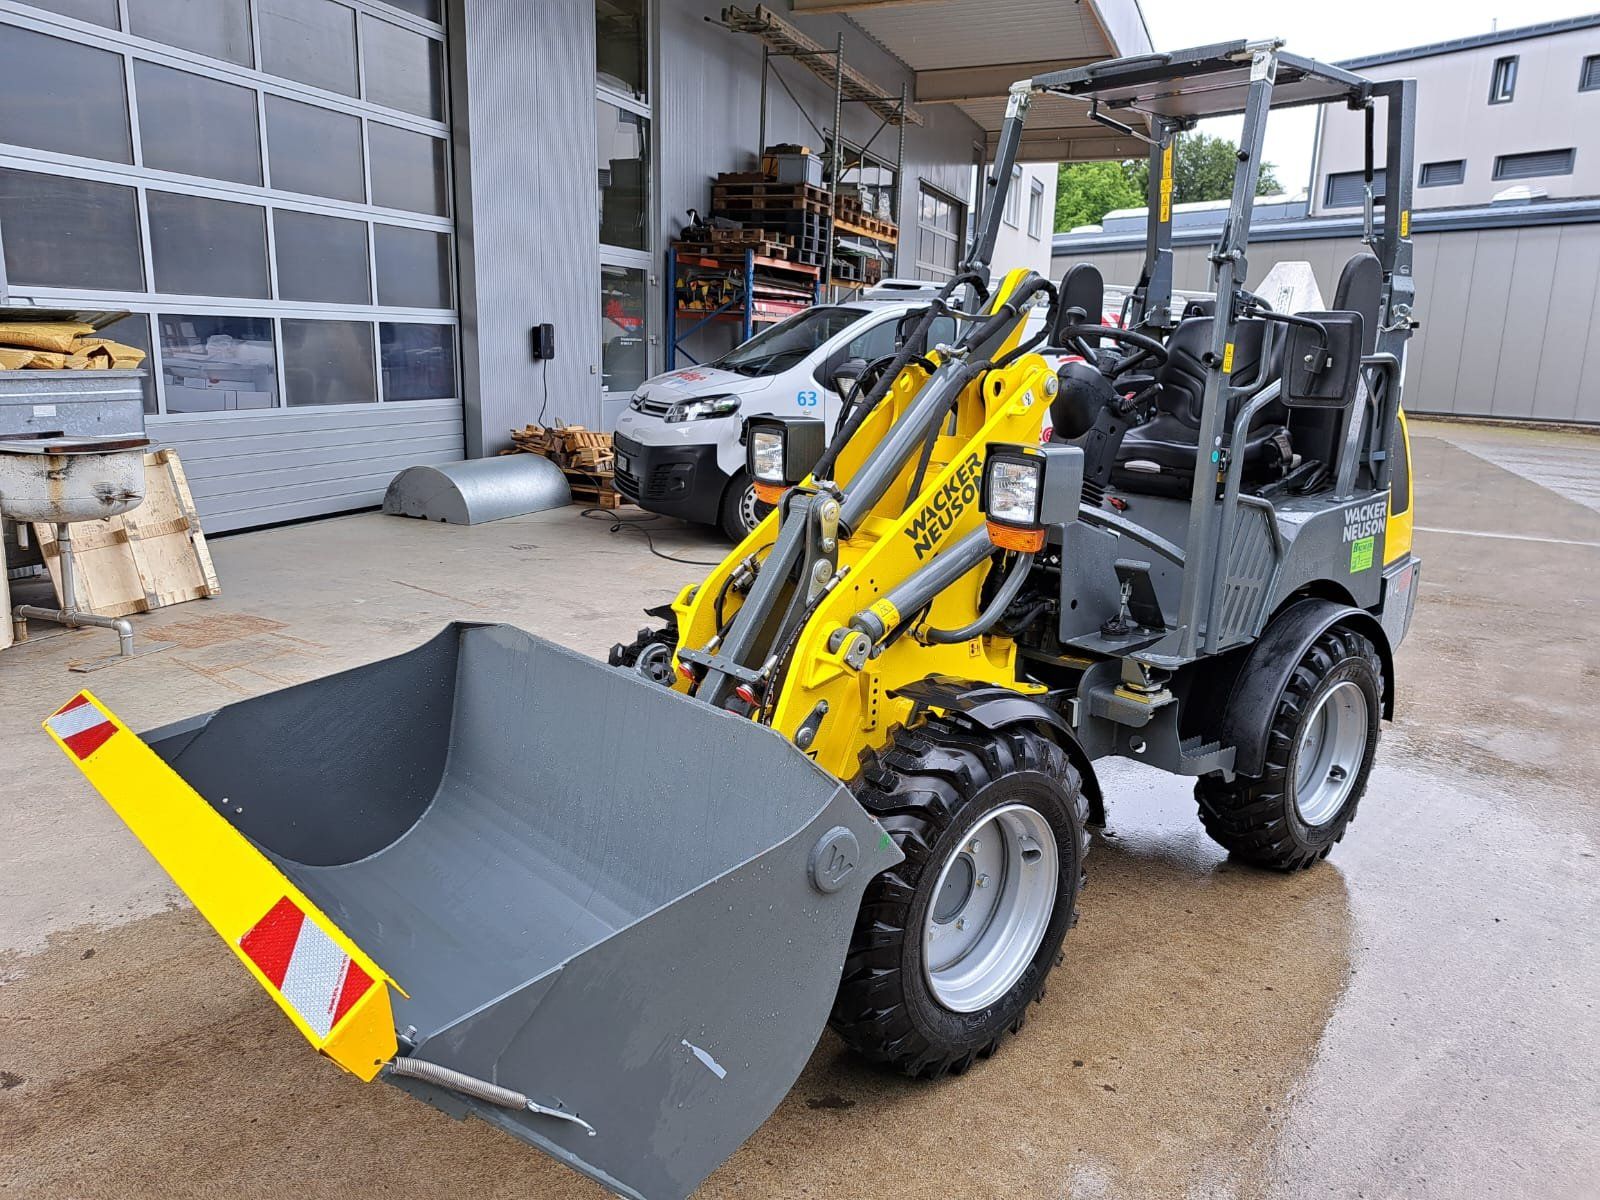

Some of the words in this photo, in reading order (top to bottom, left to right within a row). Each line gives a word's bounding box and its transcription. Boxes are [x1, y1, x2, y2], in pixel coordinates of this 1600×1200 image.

[797, 391, 817, 406] 63
[904, 452, 983, 540] WACKER
[1344, 502, 1387, 525] WACKER
[1342, 517, 1386, 543] NEUSON
